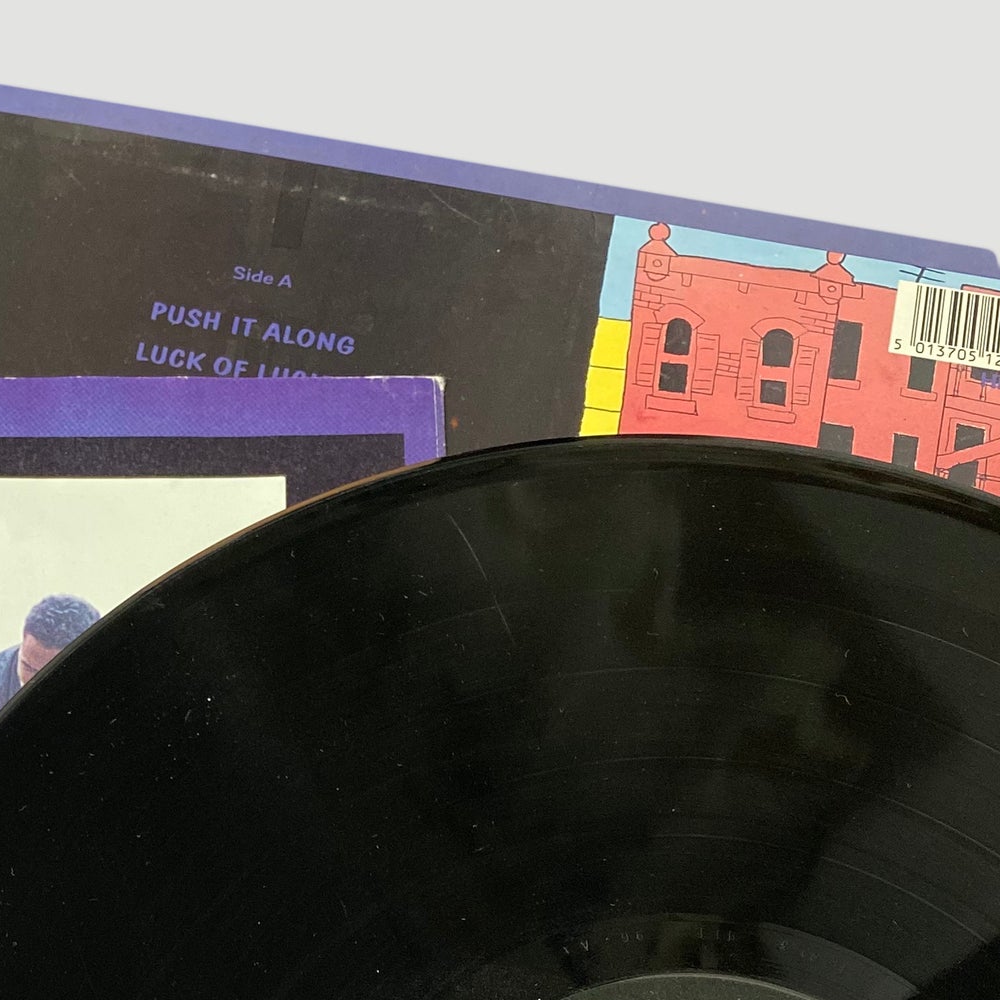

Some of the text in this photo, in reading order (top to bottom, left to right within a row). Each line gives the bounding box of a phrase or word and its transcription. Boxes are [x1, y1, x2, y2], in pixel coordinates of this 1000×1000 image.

[233, 266, 292, 289] Side A
[150, 301, 356, 355] PUSH IT ALONG
[135, 342, 206, 372] LUCK
[213, 356, 249, 378] OF
[894, 339, 902, 350] 5
[915, 342, 976, 362] 013705
